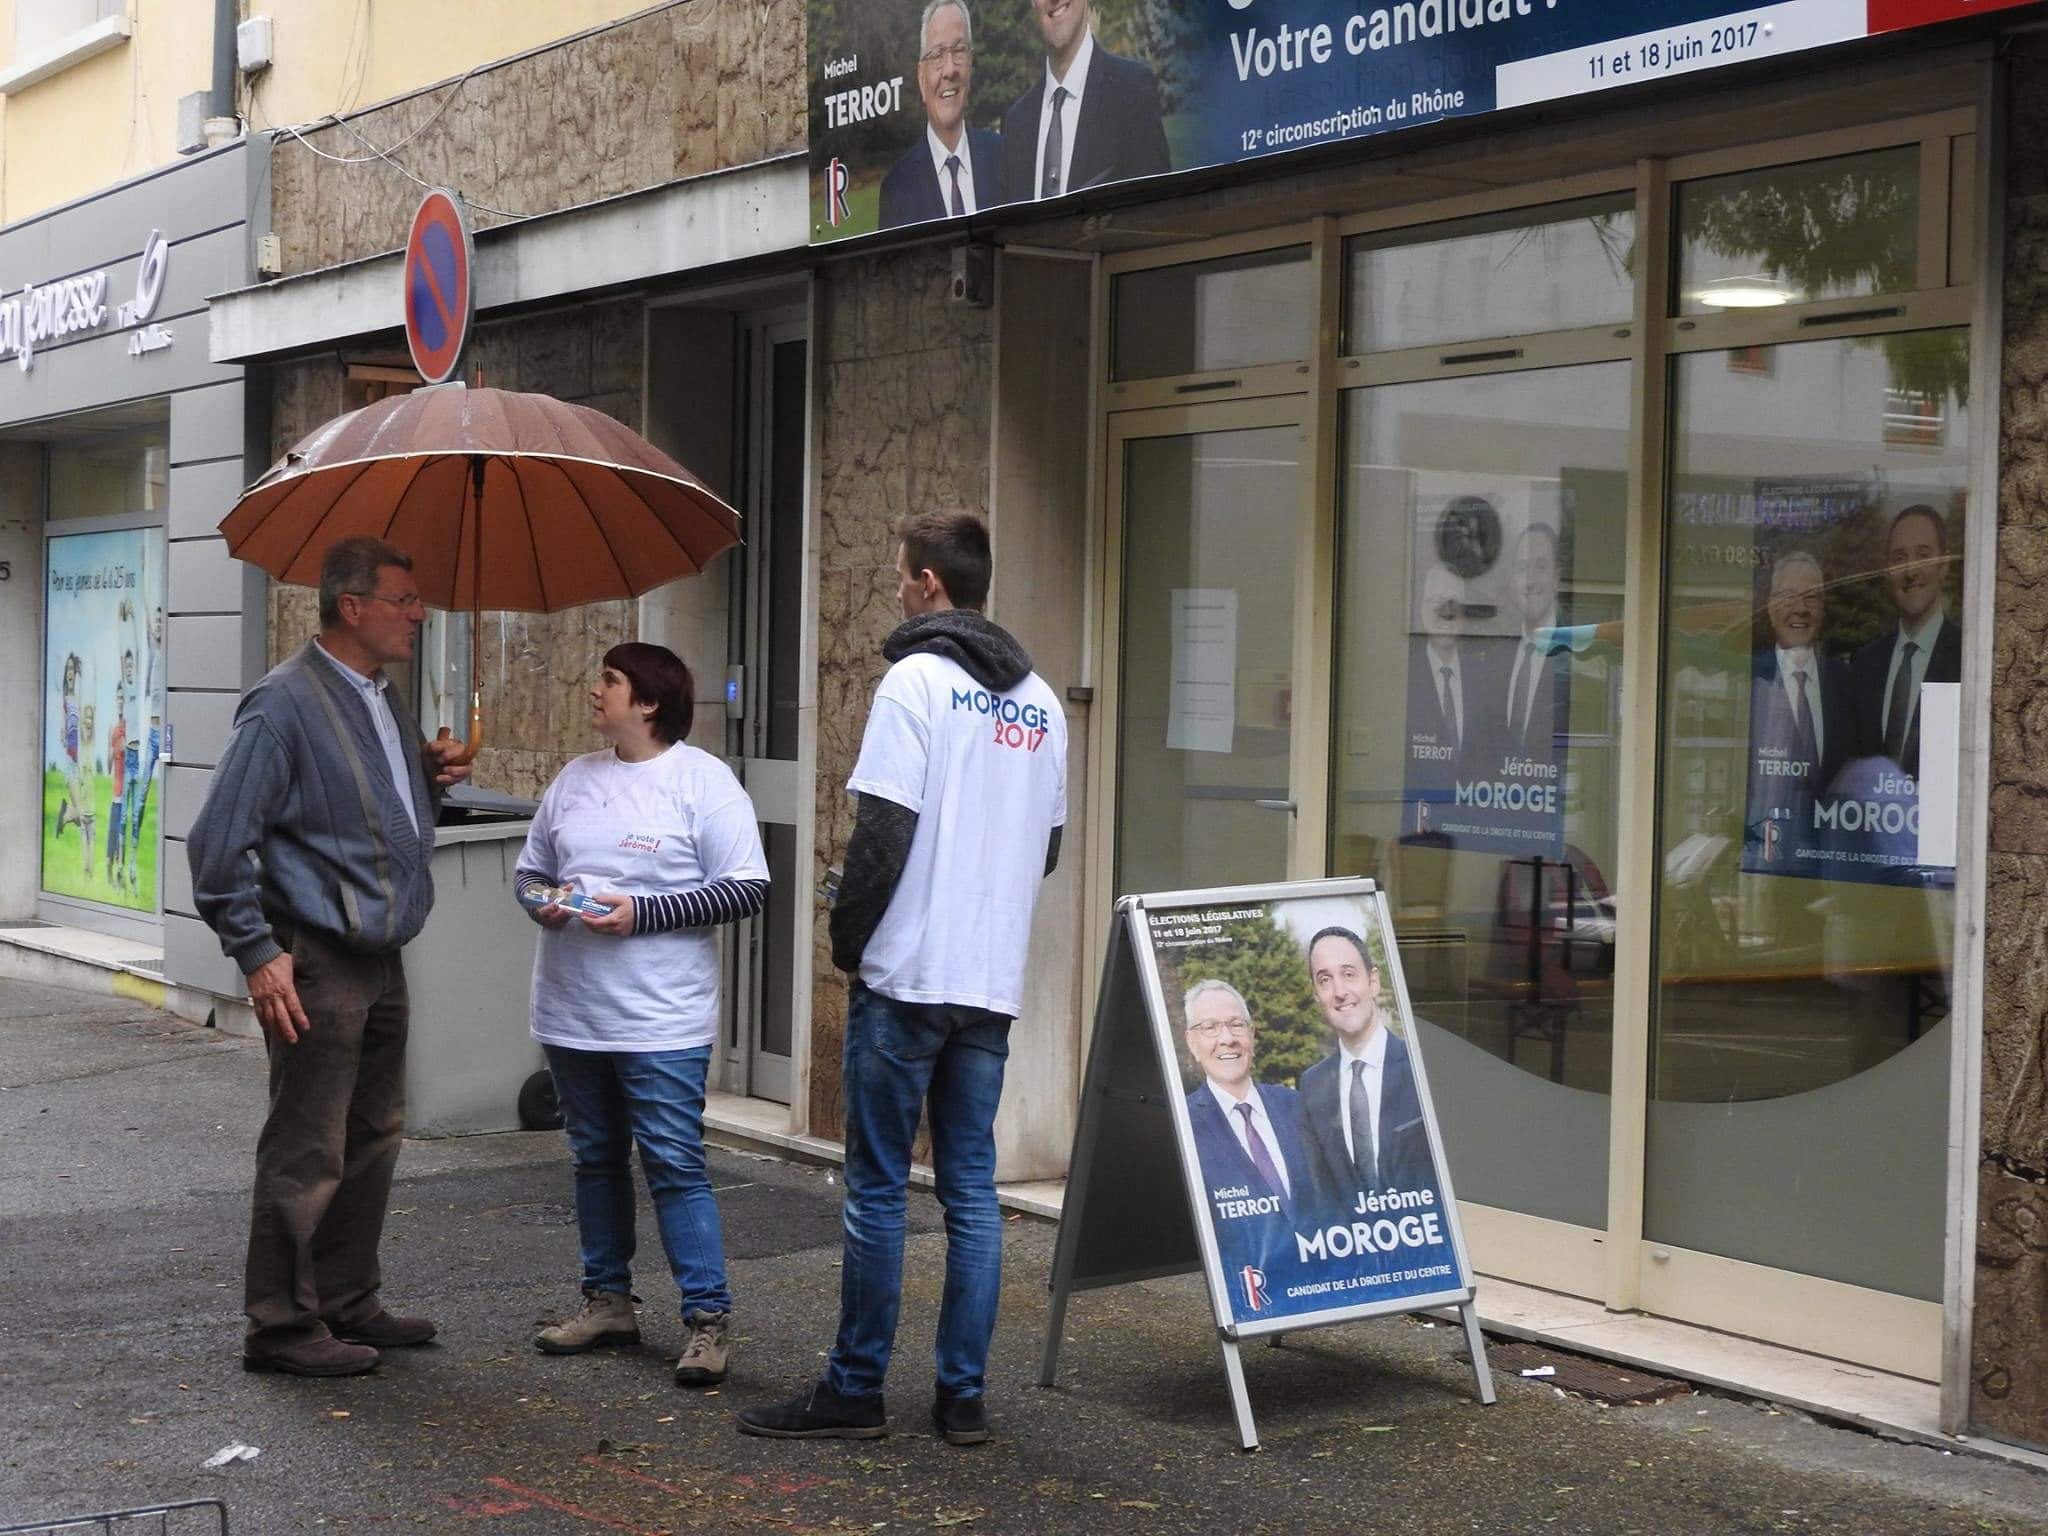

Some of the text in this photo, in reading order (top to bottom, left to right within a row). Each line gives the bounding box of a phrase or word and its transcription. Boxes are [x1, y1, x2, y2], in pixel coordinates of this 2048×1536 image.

[824, 54, 857, 80] Michel
[1229, 23, 1333, 82] Votre
[1589, 55, 1604, 79] 11
[1612, 51, 1631, 74] et
[1640, 43, 1660, 68] 18
[1665, 36, 1703, 69] juin
[1711, 22, 1758, 54] 2017
[824, 76, 904, 129] TERROT
[1266, 106, 1381, 147] circonscription
[1386, 98, 1406, 121] du
[1412, 88, 1464, 116] Rhône
[0, 288, 22, 354] on
[952, 687, 1048, 733] MOROGE
[993, 719, 1046, 753] 2017
[1413, 745, 1453, 761] TERROT
[1500, 756, 1558, 778] Jérôme
[1758, 760, 1811, 777] TERROT
[1873, 772, 1919, 795] Jérô
[1455, 780, 1557, 814] MOROGE
[1202, 909, 1264, 922] LÉGISLATIVES
[1214, 1185, 1249, 1200] Michel
[1217, 1196, 1280, 1219] TERROT
[1354, 1187, 1434, 1215] Jérôme
[1295, 1212, 1443, 1263] MOROGE
[1287, 1264, 1452, 1298] CANDIDAT DE LA DROITE ET DU CENTRE
